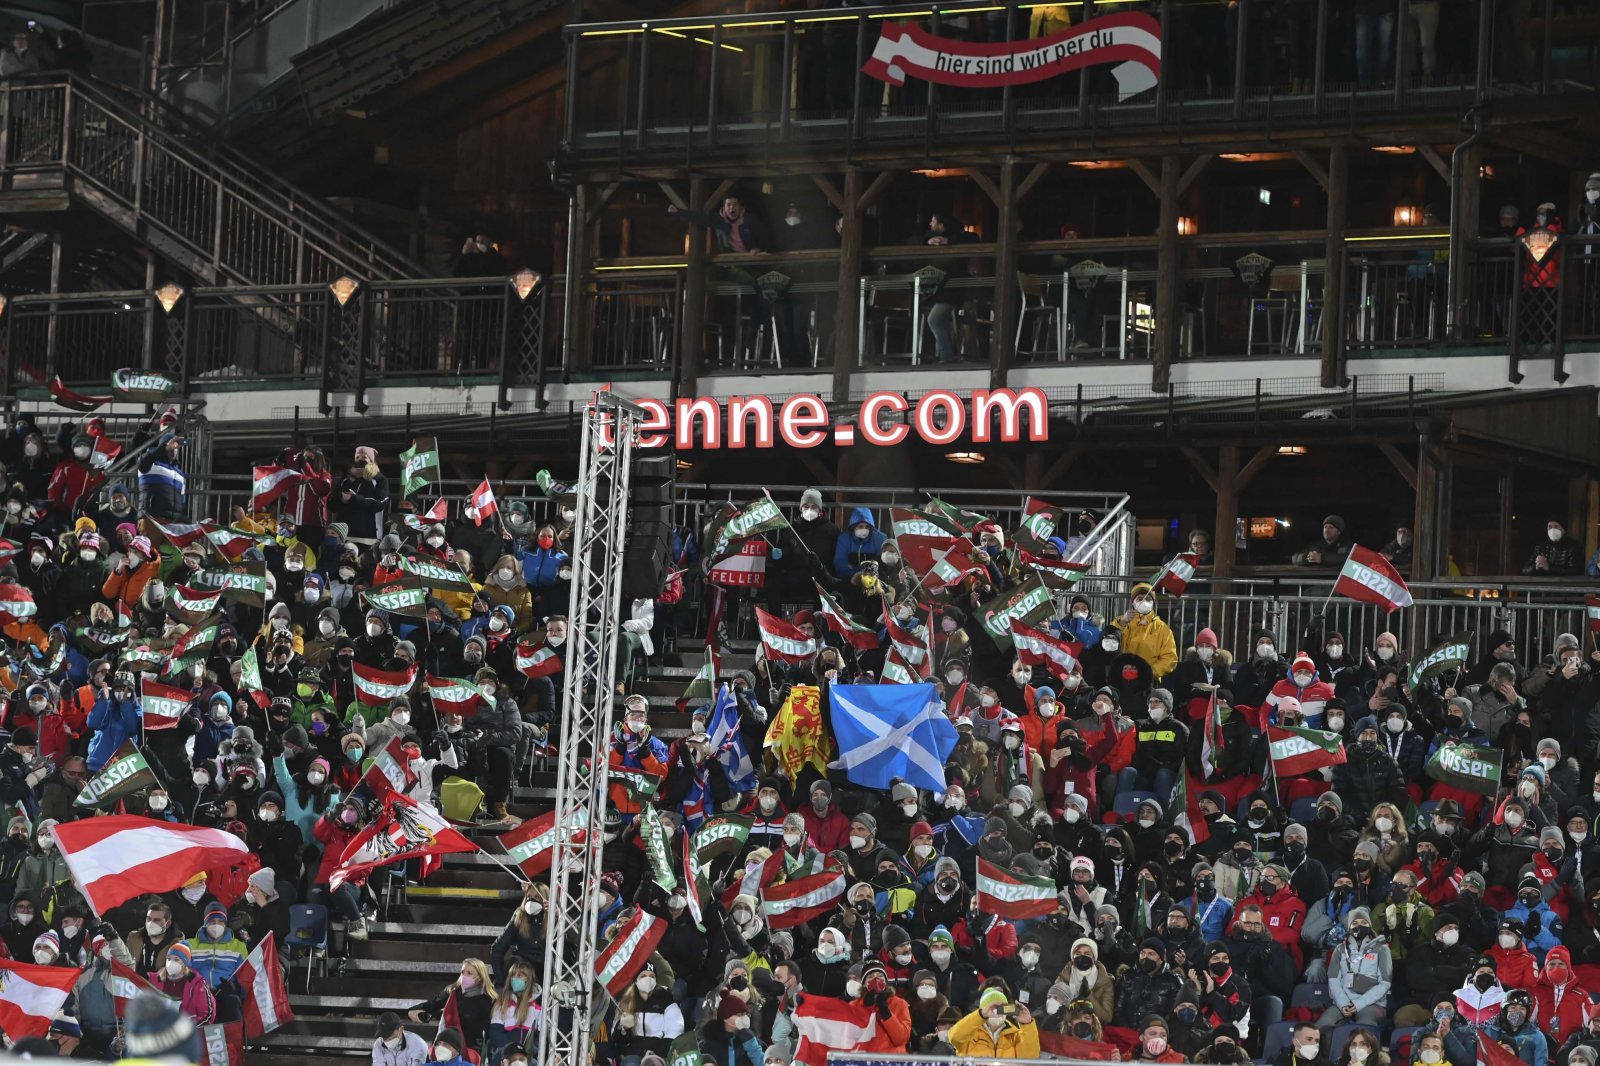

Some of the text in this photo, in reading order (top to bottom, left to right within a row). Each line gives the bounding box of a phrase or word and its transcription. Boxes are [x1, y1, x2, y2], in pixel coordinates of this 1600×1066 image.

[935, 29, 1113, 75] hier sind wir per du
[711, 571, 760, 584] FELLER
